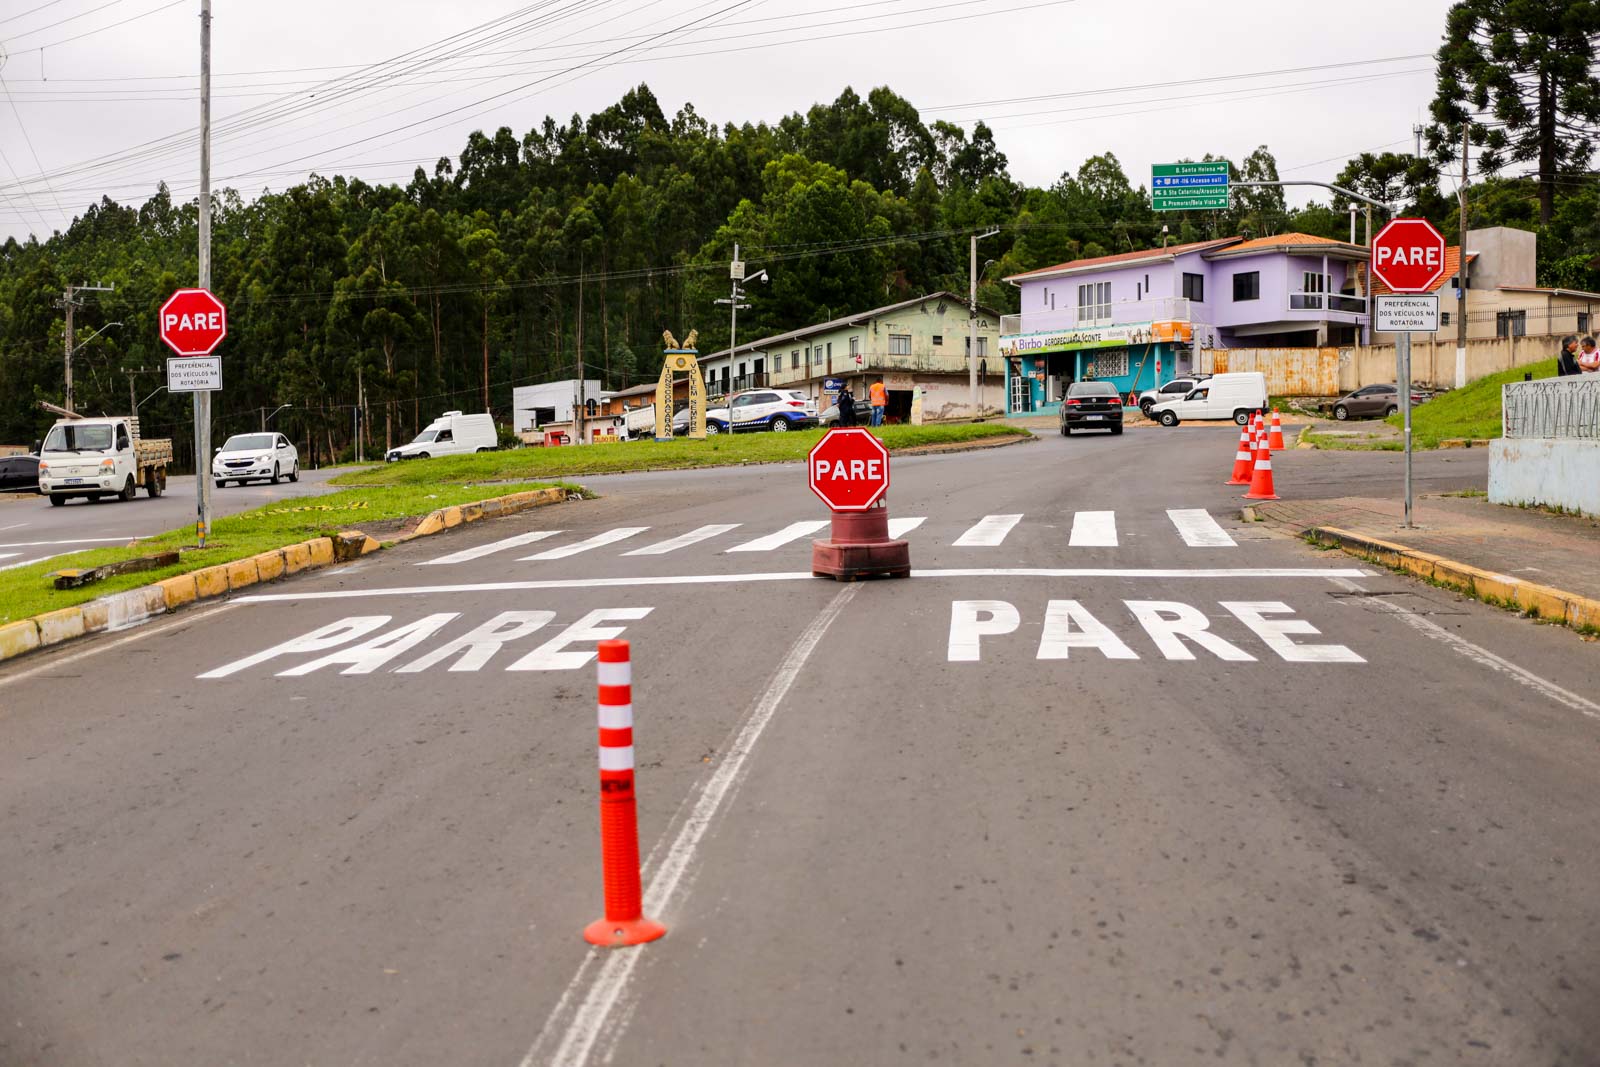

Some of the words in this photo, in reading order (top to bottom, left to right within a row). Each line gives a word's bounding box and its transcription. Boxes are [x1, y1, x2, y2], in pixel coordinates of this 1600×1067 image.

[1378, 246, 1439, 266] PARE
[165, 312, 220, 332] PARE
[1019, 338, 1042, 350] Birbo
[816, 460, 881, 480] PARE
[948, 600, 1368, 662] PARE
[195, 607, 656, 678] PARE
